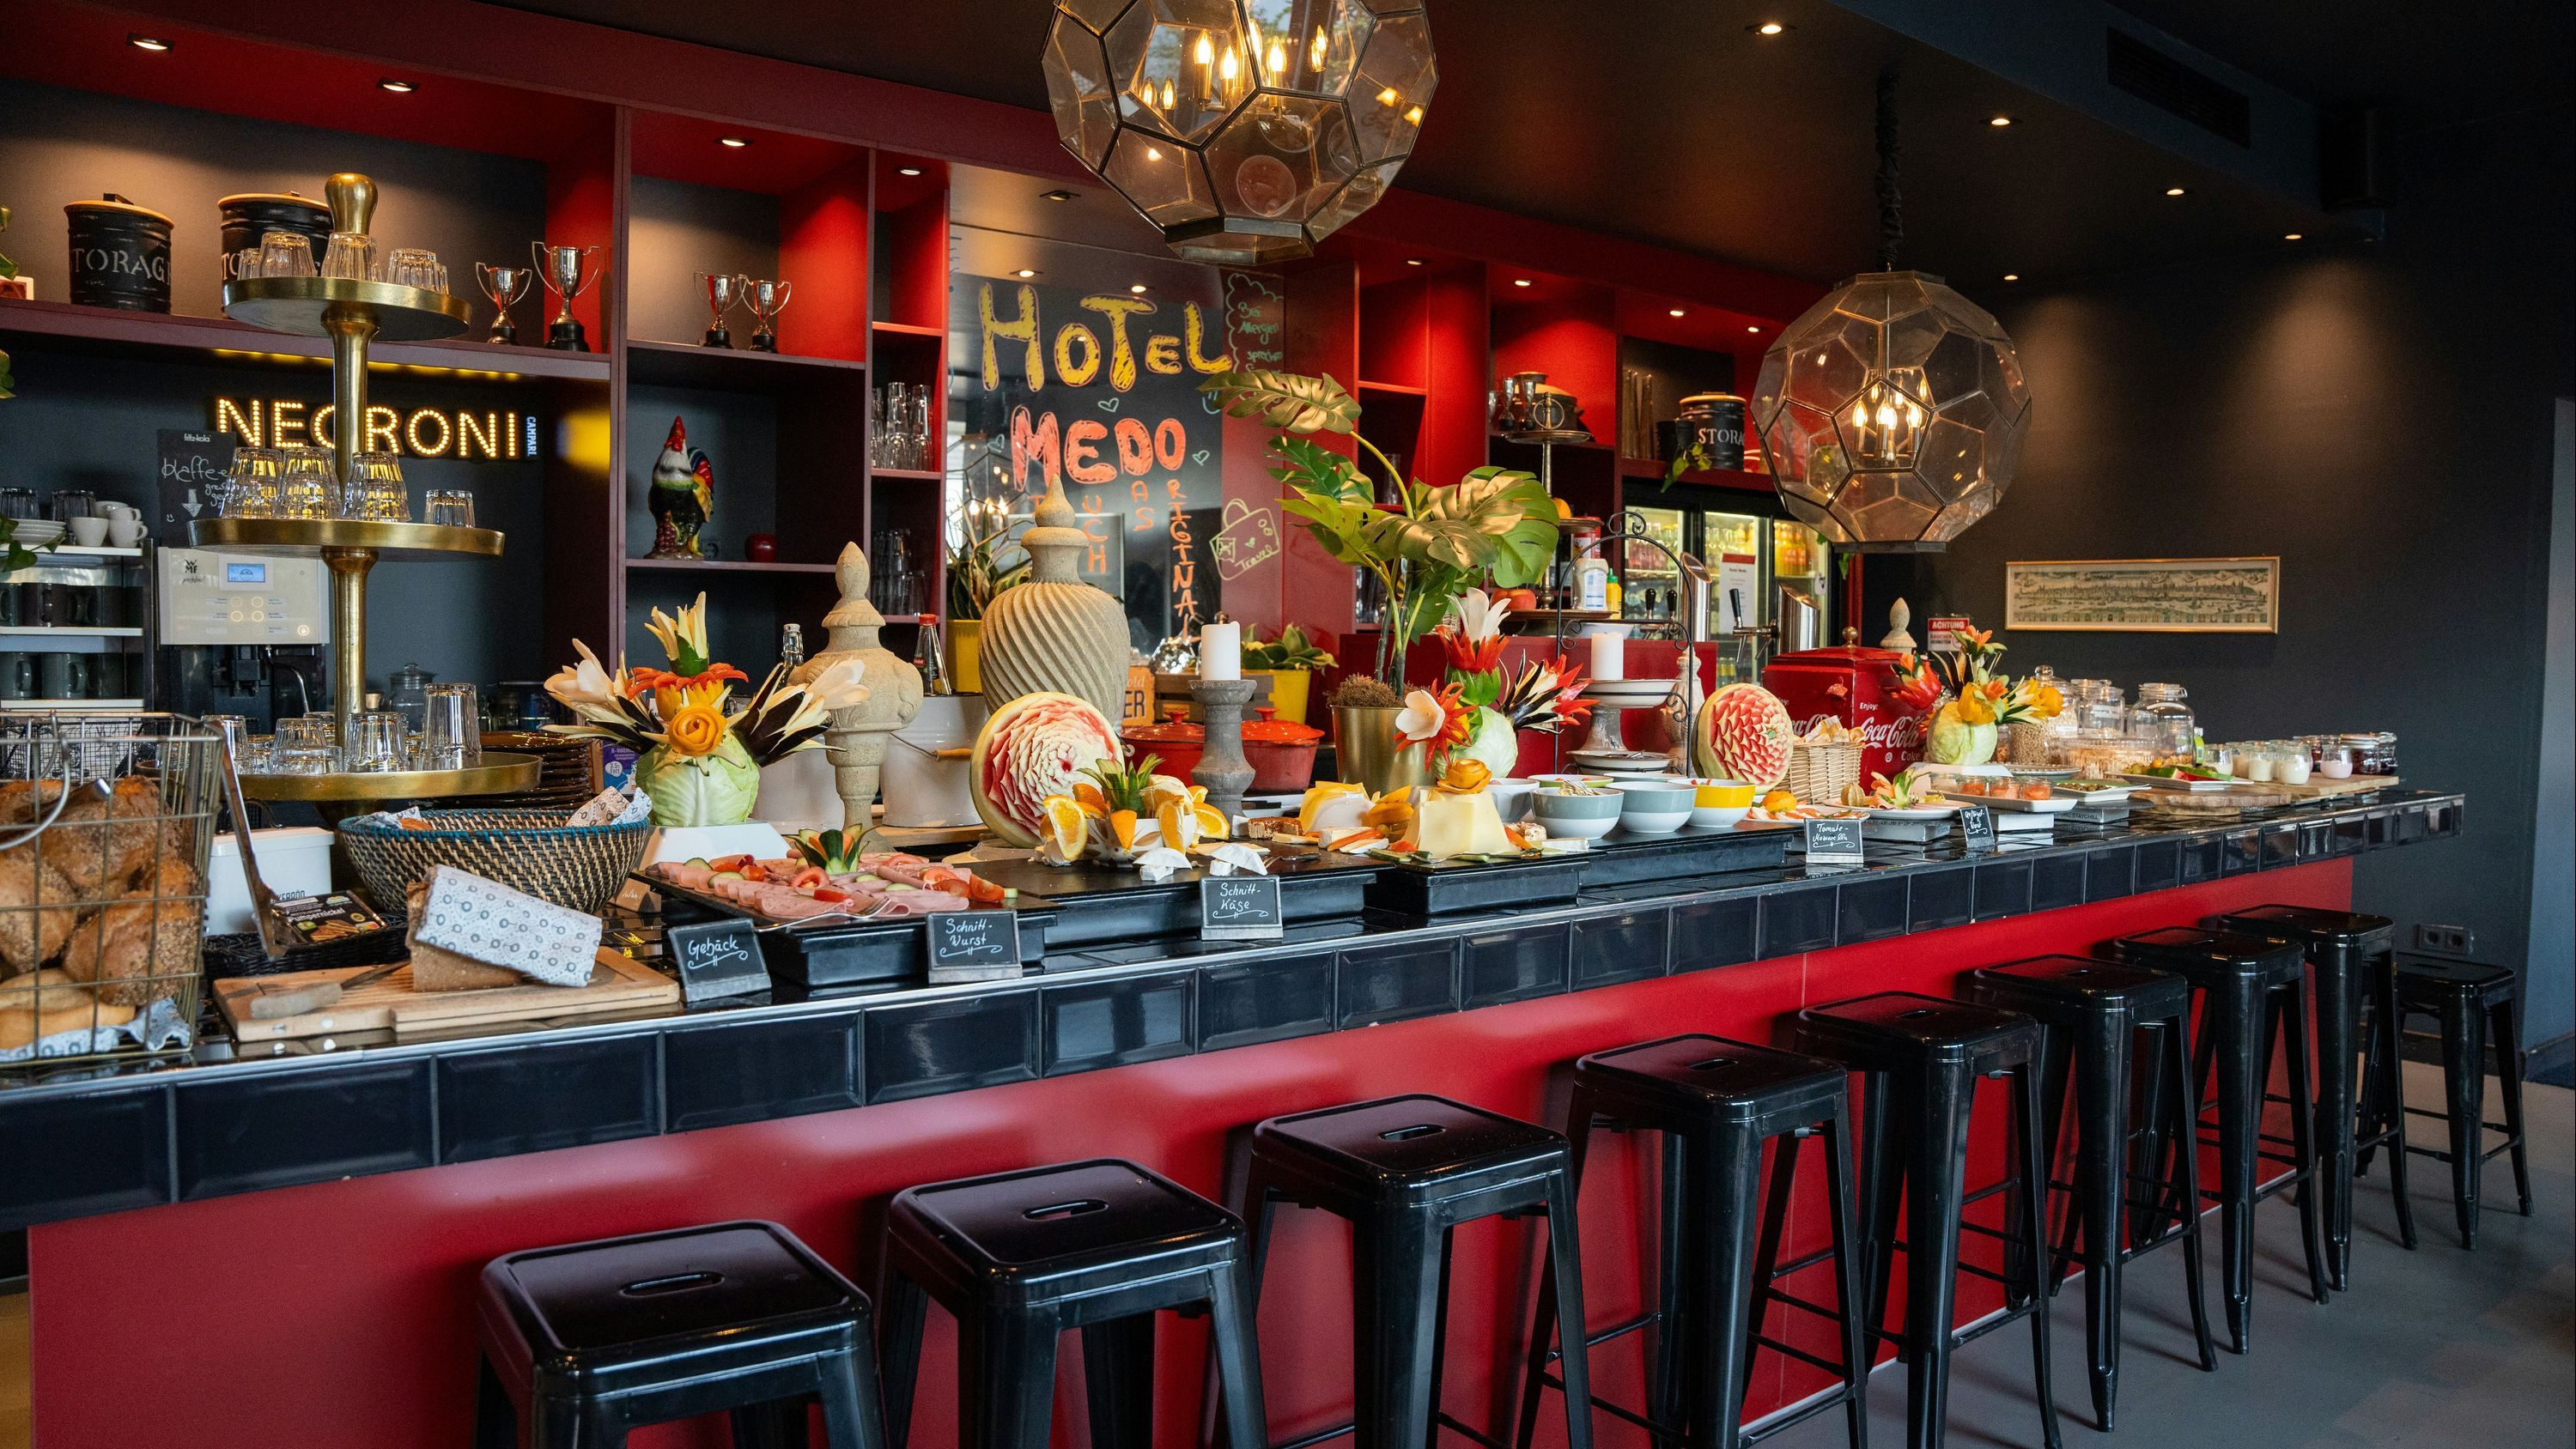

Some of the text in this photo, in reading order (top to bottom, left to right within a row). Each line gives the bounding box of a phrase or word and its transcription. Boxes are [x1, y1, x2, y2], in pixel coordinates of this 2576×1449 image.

[979, 282, 1233, 392] HOTEL
[526, 415, 537, 457] CAMPARI
[1010, 403, 1187, 492] MEDO
[161, 455, 228, 482] Kaffee
[1235, 544, 1274, 570] Travel
[1932, 621, 1965, 630] ACHTUNG
[1127, 675, 1145, 688] old
[1123, 690, 1145, 718] ER
[1859, 702, 1878, 711] Enjoy:
[1219, 882, 1261, 897] Schnitt-
[1220, 898, 1250, 912] Käse
[945, 918, 993, 935] Schnitt-
[688, 934, 740, 961] Gebäck
[950, 932, 987, 947] Wurst
